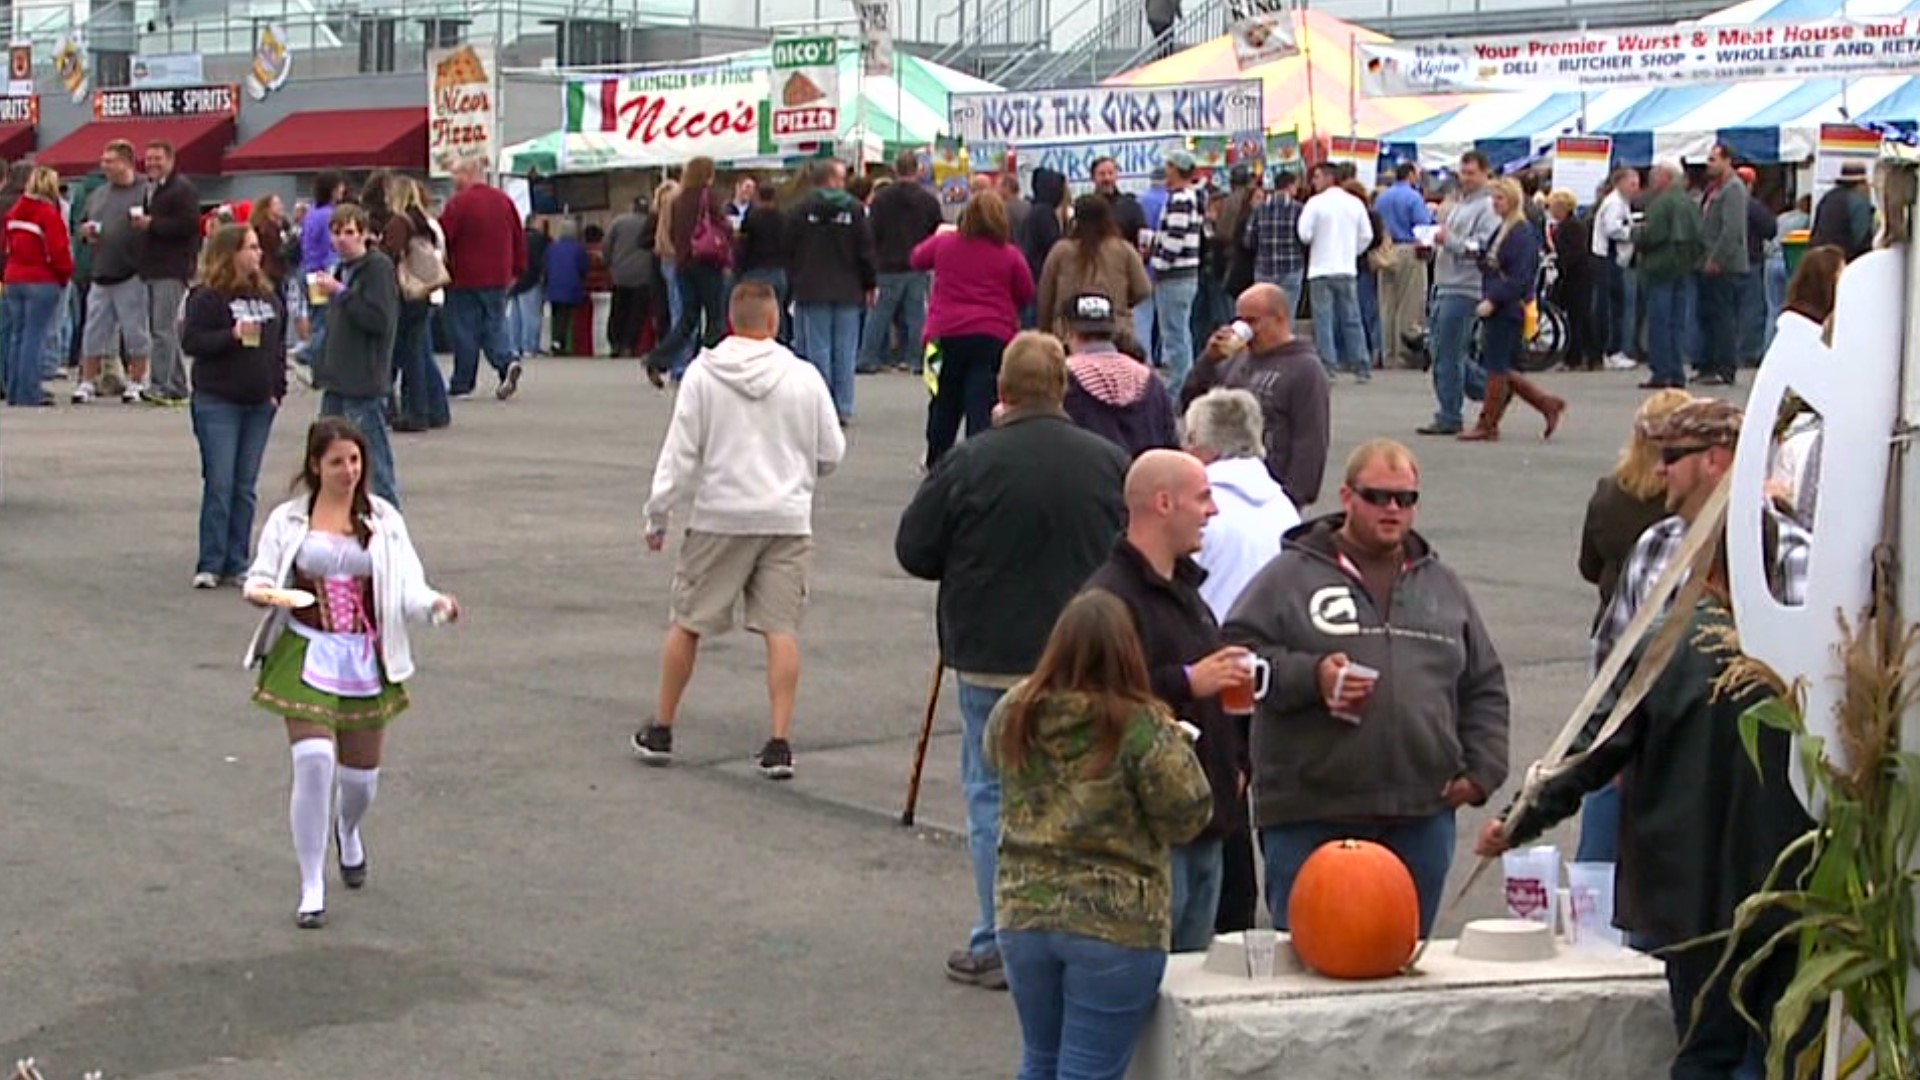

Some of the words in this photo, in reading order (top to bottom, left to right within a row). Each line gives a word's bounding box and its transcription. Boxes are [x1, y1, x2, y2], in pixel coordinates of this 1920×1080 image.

[1474, 43, 1520, 60] Your
[1529, 39, 1607, 57] Premier
[1618, 34, 1681, 50] Wurst
[1691, 32, 1707, 47] &
[1718, 27, 1774, 46] Meat
[1784, 23, 1854, 43] House
[1864, 18, 1907, 38] and
[1504, 61, 1537, 75] DELI
[1559, 55, 1632, 72] BUTCHER
[1641, 52, 1686, 68] SHOP
[1716, 44, 1826, 64] WHOLESALE
[1833, 41, 1873, 56] AND
[102, 92, 131, 116] BEER
[139, 90, 174, 113] WINE
[183, 89, 231, 112] SPIRITS
[619, 95, 756, 143] Nico's
[982, 93, 1043, 139] NOTIS
[1052, 95, 1090, 135] THE
[1101, 90, 1161, 134] GYRO
[1172, 89, 1226, 131] KING
